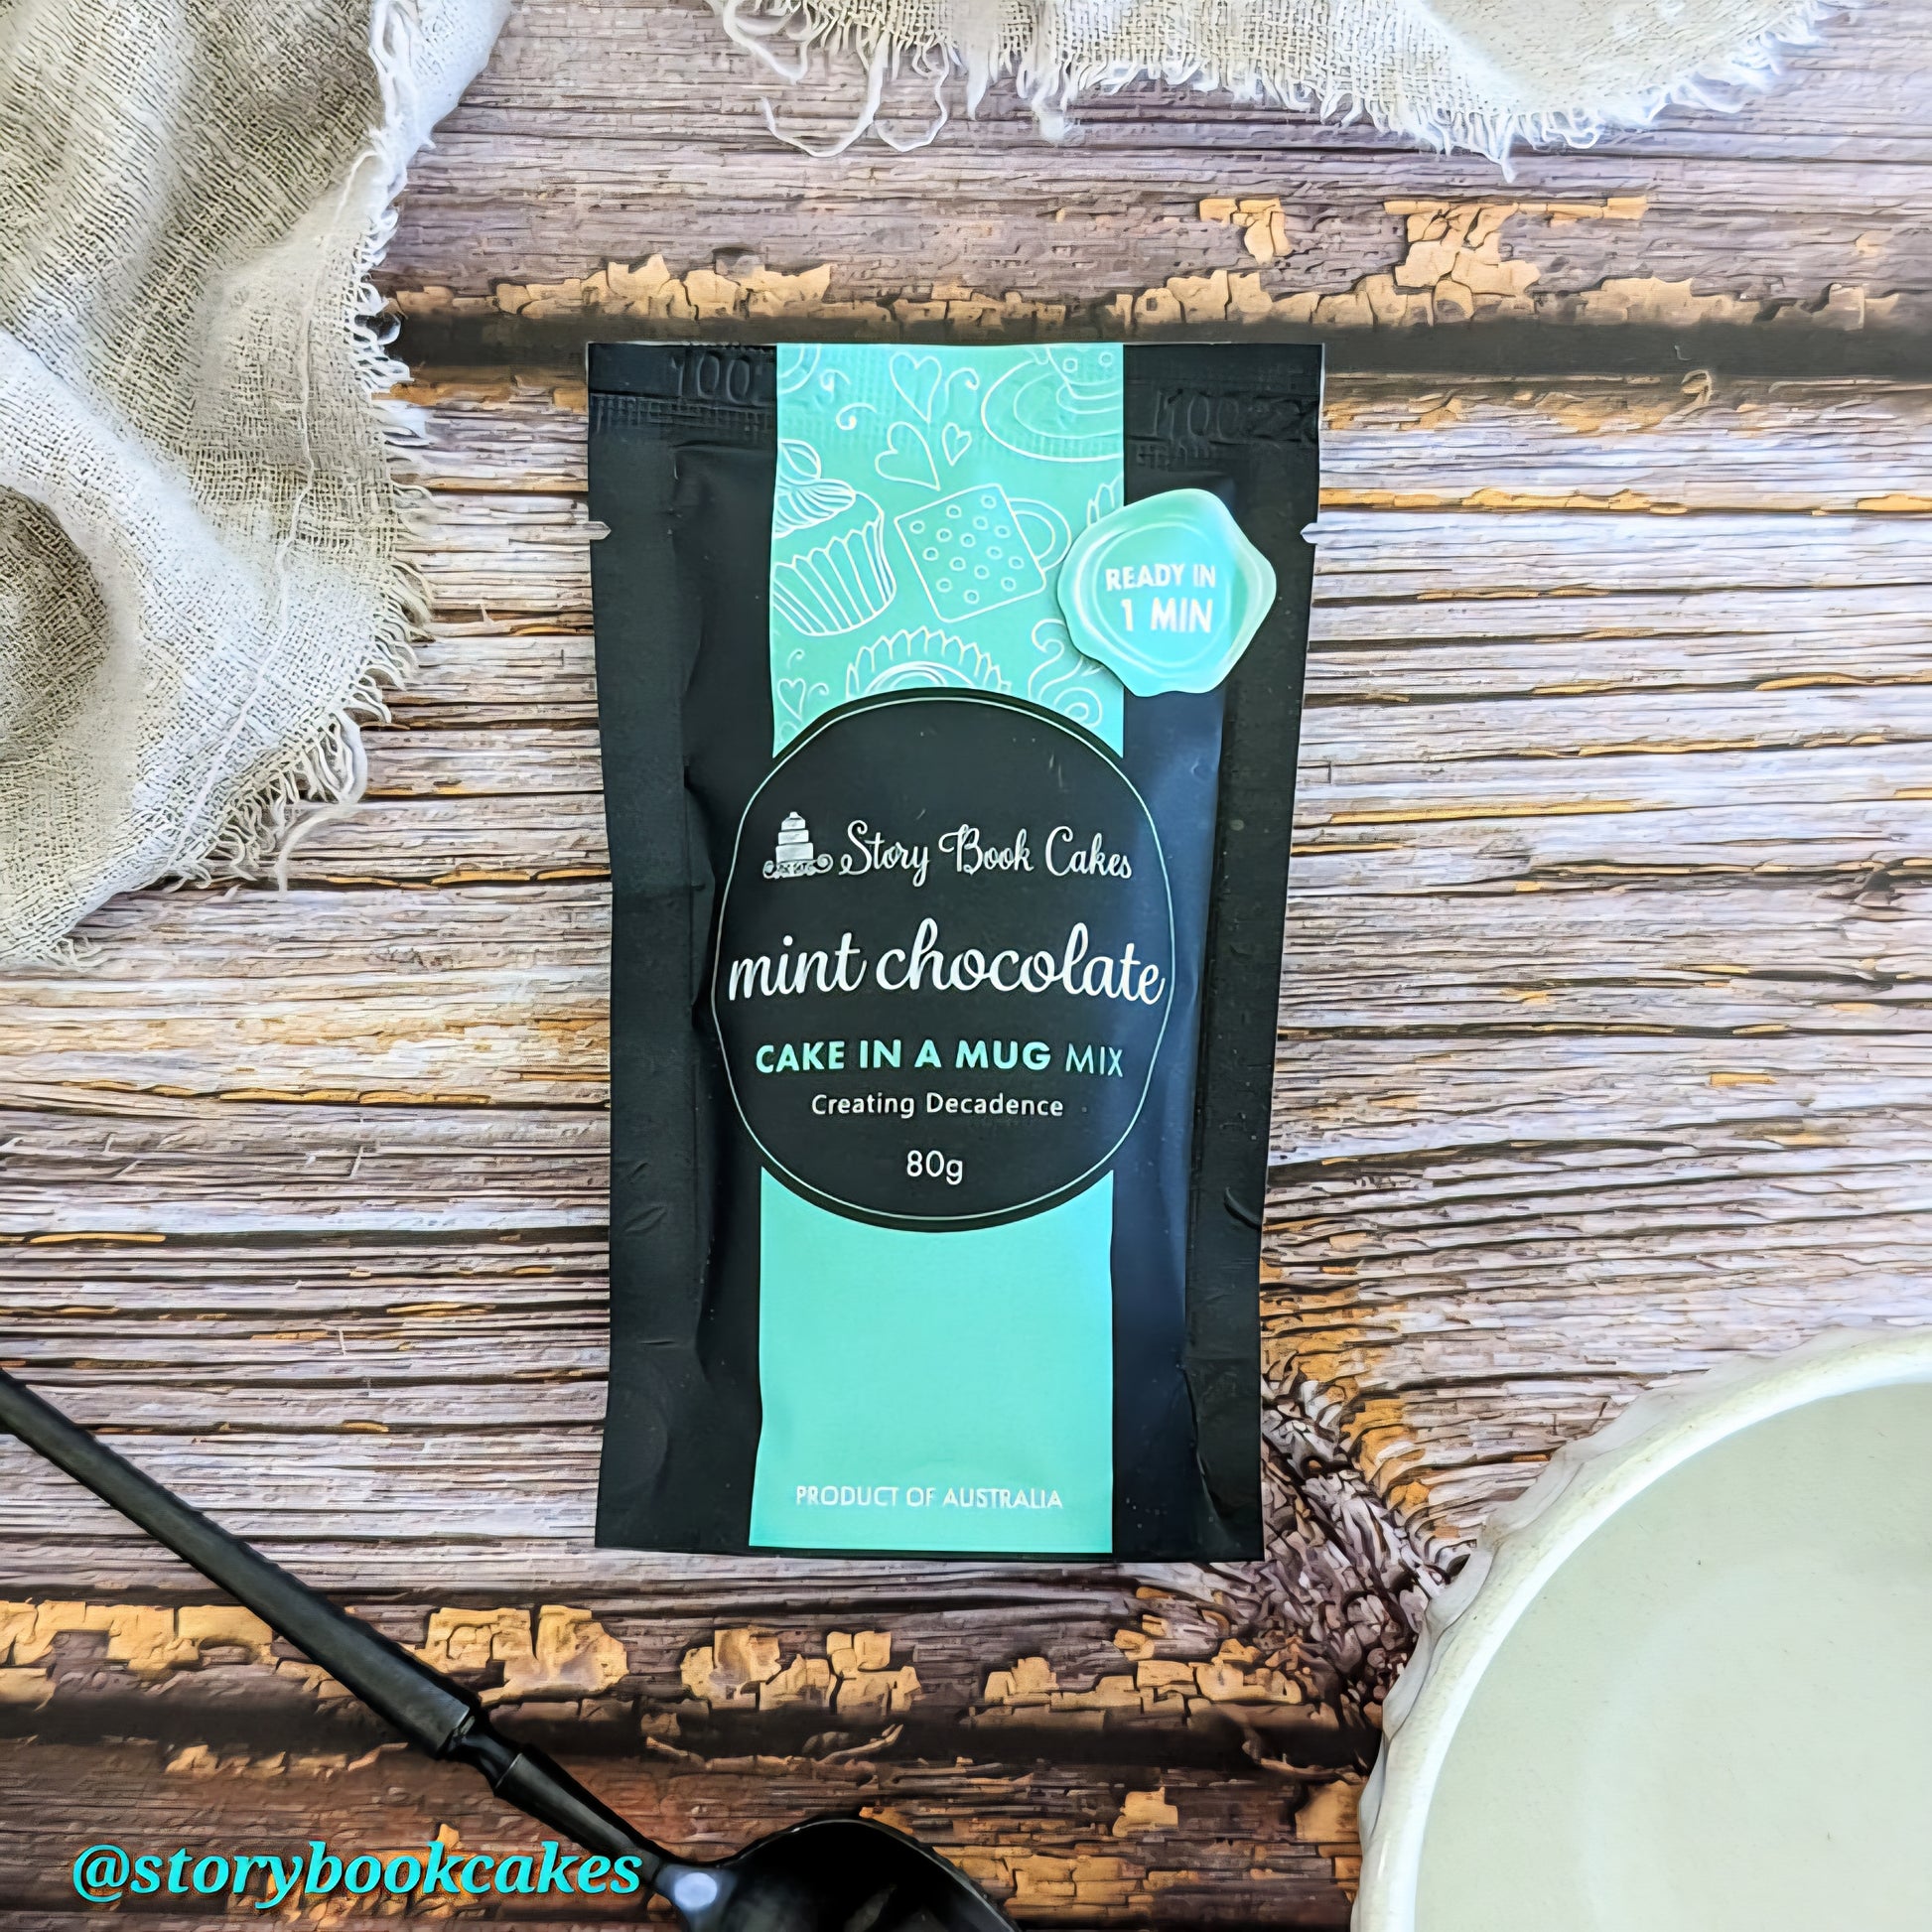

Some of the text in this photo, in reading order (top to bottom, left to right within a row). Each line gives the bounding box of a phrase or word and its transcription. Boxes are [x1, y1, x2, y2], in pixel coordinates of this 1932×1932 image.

[1105, 563, 1216, 592] READY IN
[1121, 597, 1213, 633] 1 MIN
[838, 819, 1133, 888] Story Book Cakes
[728, 917, 1167, 1006] mint chocolate
[756, 1038, 1124, 1078] CAKE IN A MUG MIX
[811, 1091, 1063, 1120] Creating Decadence
[906, 1150, 963, 1185] 80g
[796, 1485, 1062, 1509] PRODUCT OF AUSTRALIA
